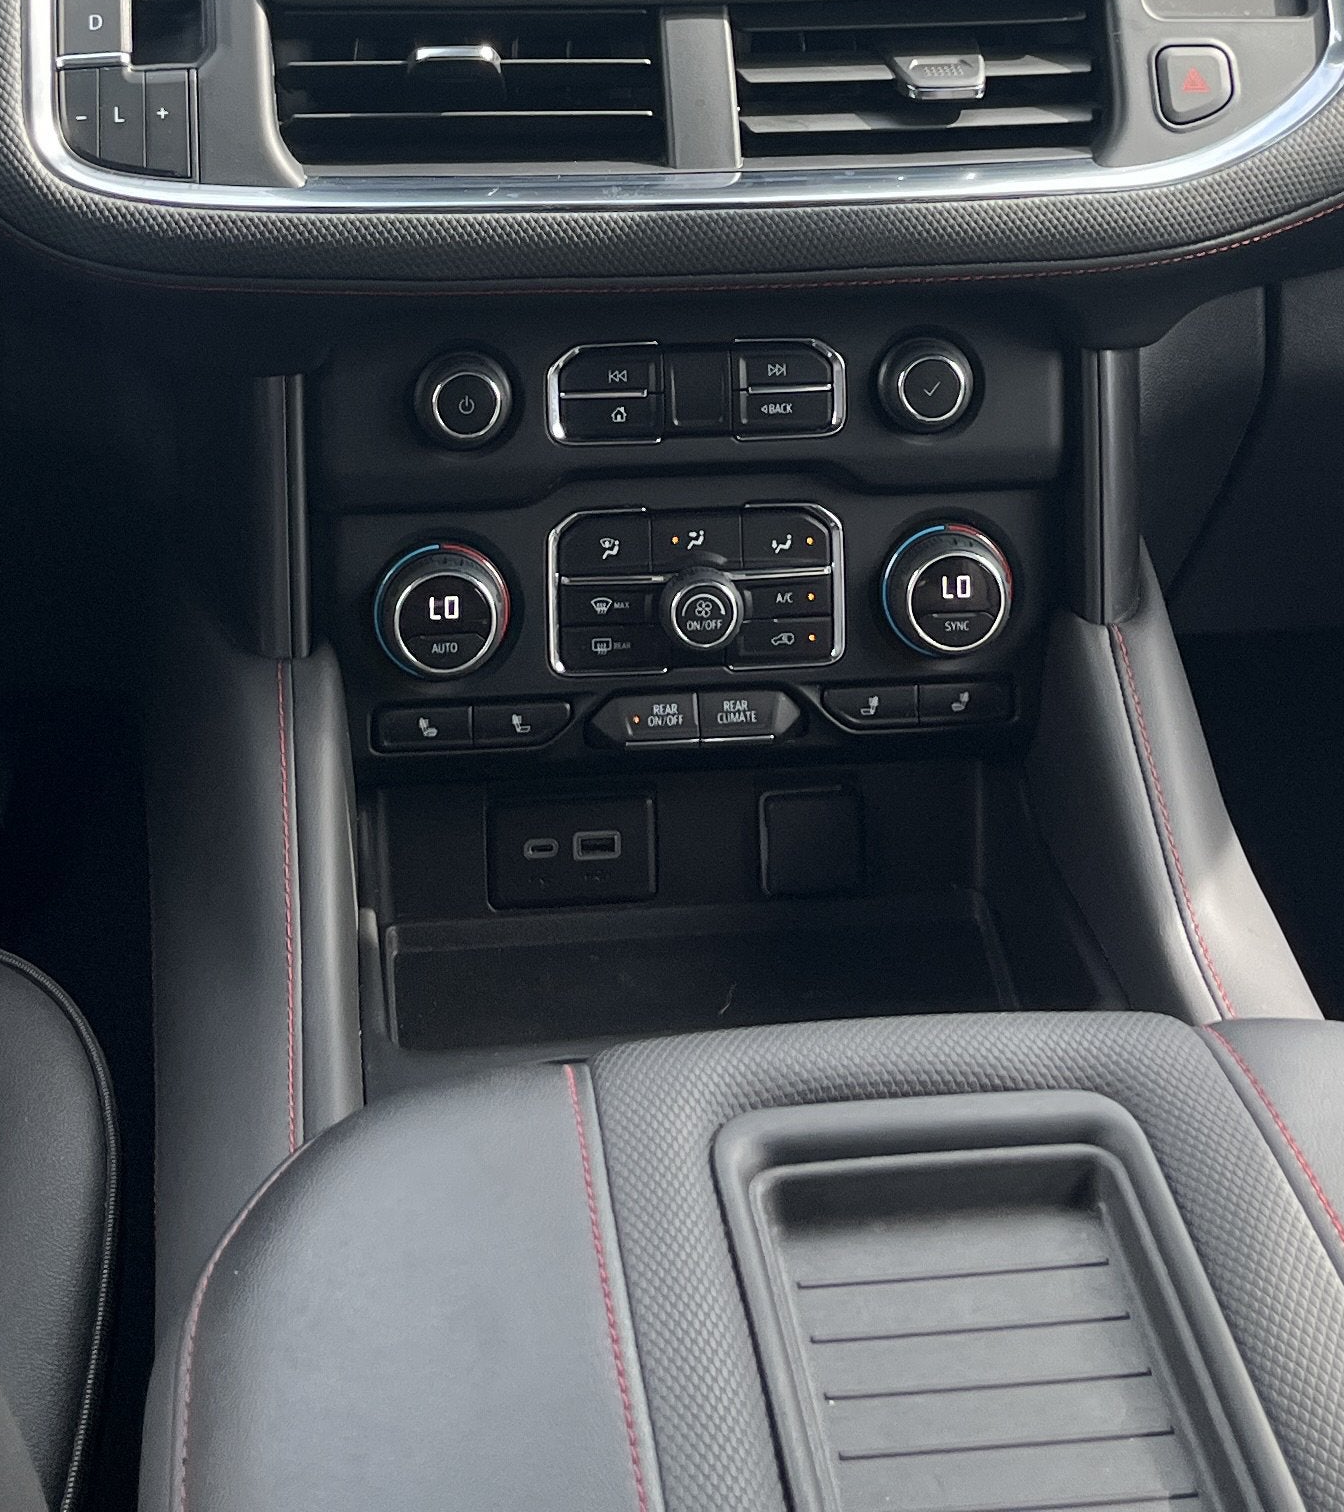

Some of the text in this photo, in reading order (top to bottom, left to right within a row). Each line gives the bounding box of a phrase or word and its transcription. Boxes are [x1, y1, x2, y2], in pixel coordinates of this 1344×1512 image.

[88, 14, 103, 30] D
[114, 106, 125, 123] L
[768, 402, 793, 415] BACK
[941, 575, 971, 599] LO
[776, 592, 793, 604] A/C
[429, 595, 459, 620] LO
[613, 601, 630, 609] MAX
[686, 619, 723, 632] ON/OFF
[944, 620, 970, 632] SYNC
[431, 642, 458, 654] AUTO
[653, 703, 678, 715] REAR
[723, 699, 748, 712] REAR
[647, 714, 684, 727] ON/OFF
[717, 710, 758, 724] CLIMATE
